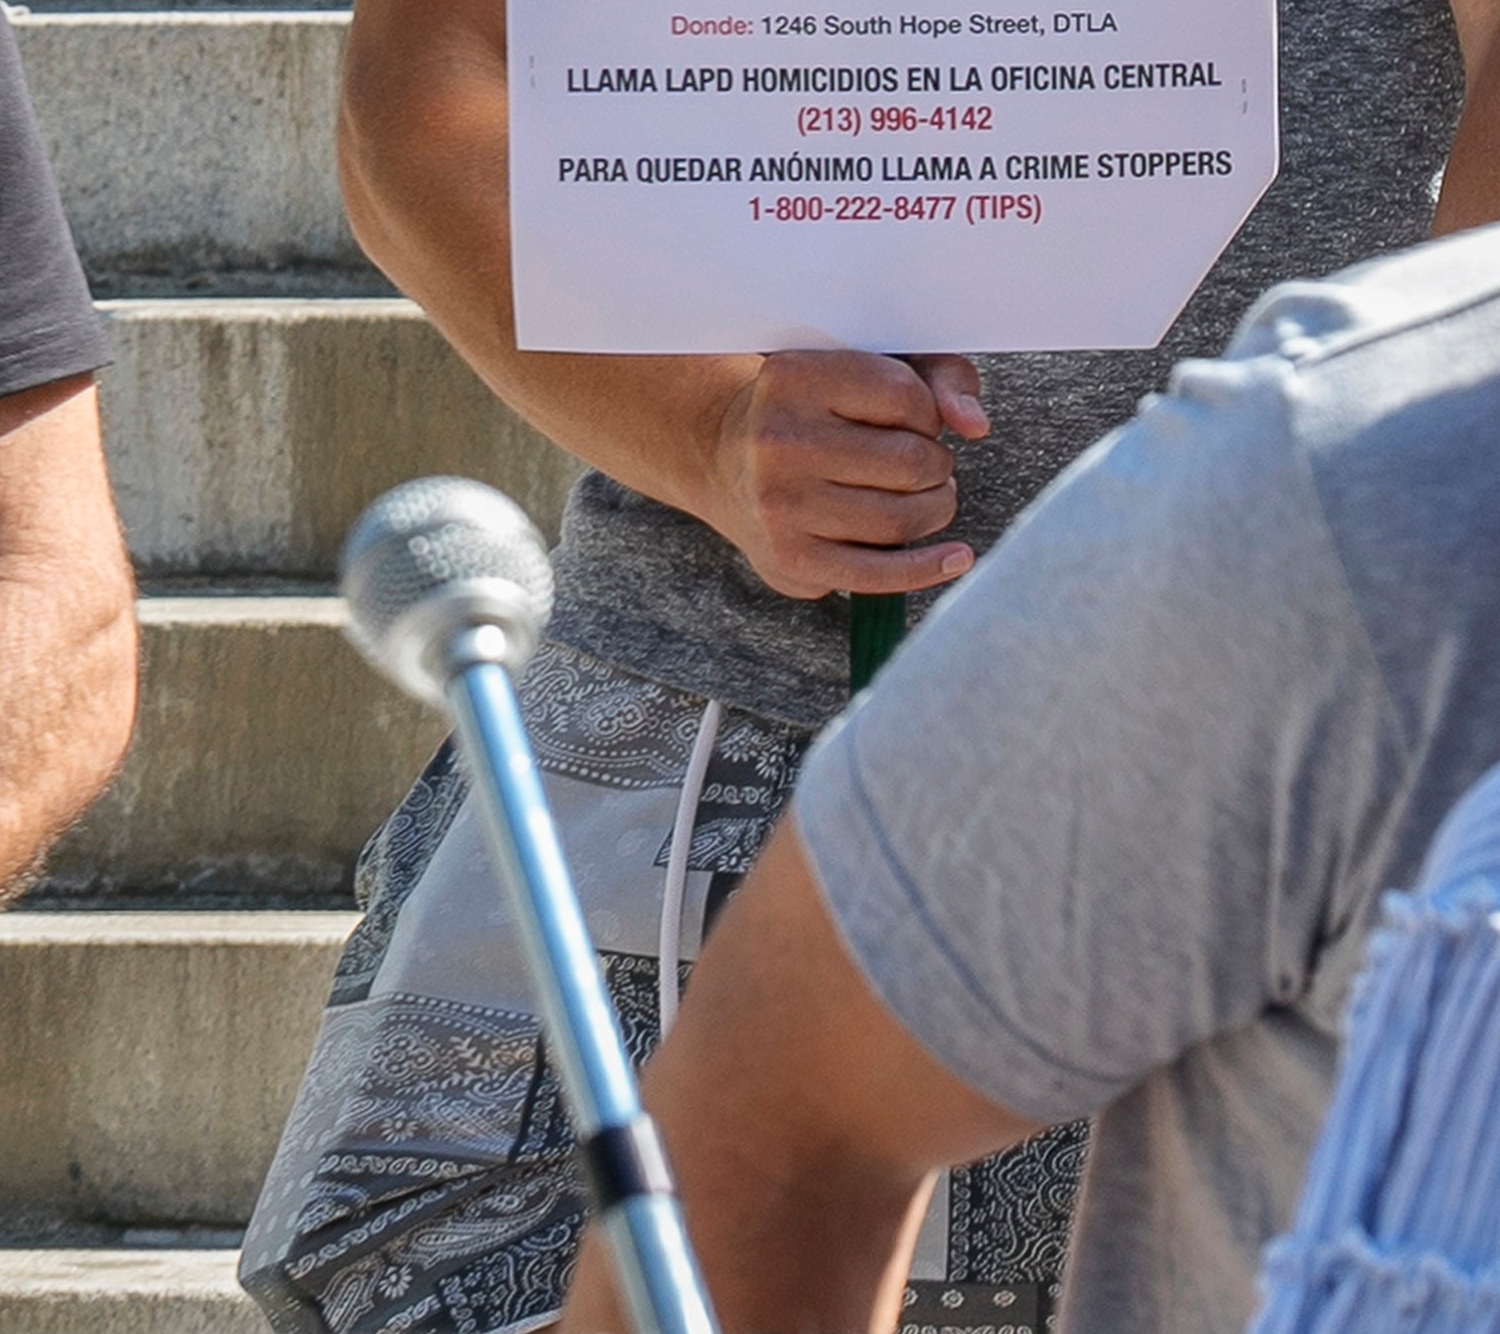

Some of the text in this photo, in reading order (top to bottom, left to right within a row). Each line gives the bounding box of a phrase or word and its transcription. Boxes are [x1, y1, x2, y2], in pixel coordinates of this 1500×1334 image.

[671, 12, 1118, 39] Donde: 1246 South Hope Street, DTLA
[567, 62, 1222, 93] LLAMA LAPD HOMICIDIOS EN LA OFICINA CENTRAL
[797, 106, 993, 137] (213) 996-4142
[559, 150, 1232, 184] PARA QUEDAR ANÓNIMO LLAMA A CRIME STOPPERS
[749, 194, 1042, 226] 1-800-222-8477 (TIPS)
